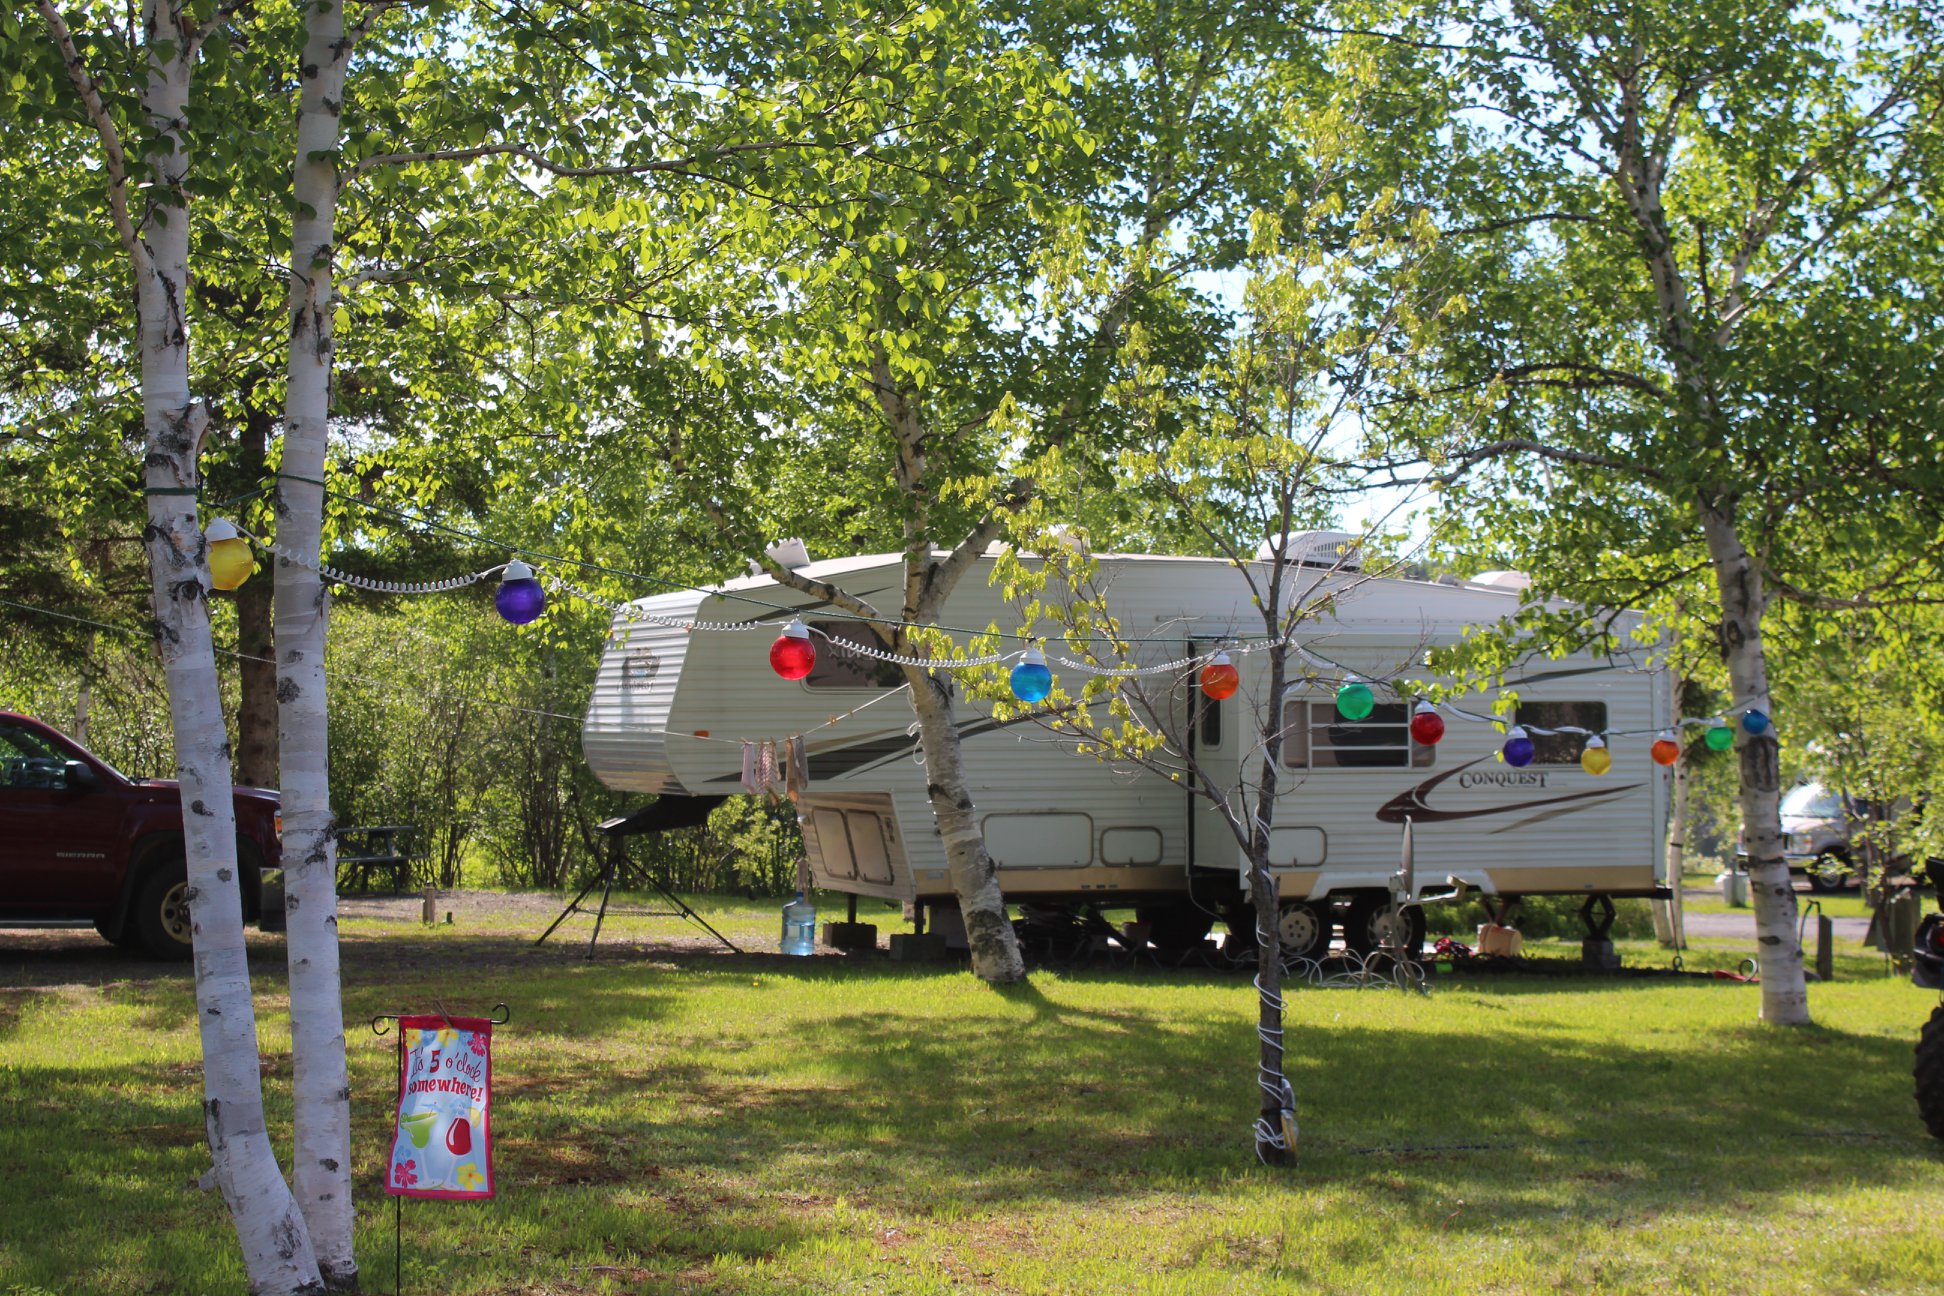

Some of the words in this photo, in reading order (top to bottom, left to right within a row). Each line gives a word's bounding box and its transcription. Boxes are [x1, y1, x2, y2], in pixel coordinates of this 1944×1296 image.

[1459, 771, 1548, 788] CONQUEST
[429, 1049, 441, 1073] 5
[445, 1052, 482, 1083] o'clock
[408, 1077, 483, 1102] somewhere!
